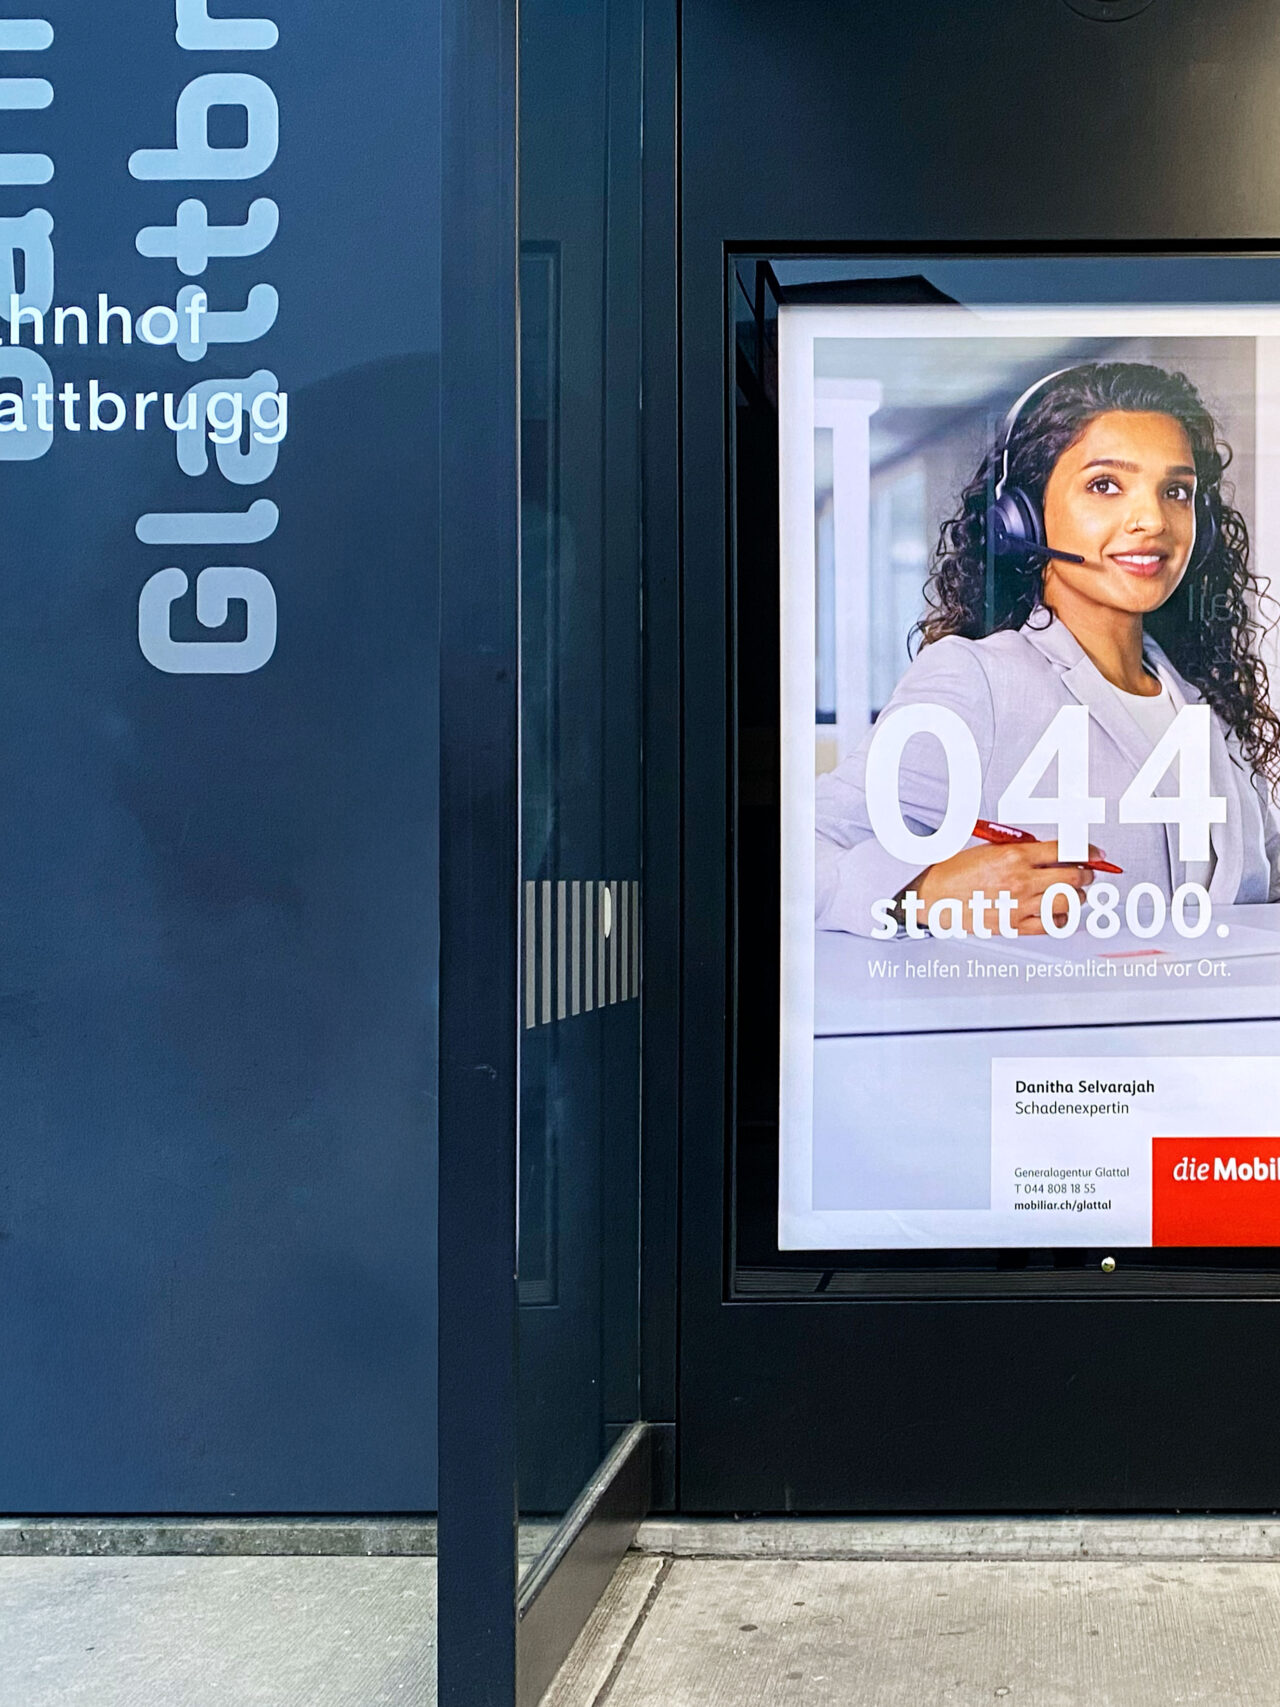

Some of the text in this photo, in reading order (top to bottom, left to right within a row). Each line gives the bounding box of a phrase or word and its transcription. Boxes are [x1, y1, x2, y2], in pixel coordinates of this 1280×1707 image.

[0, 293, 207, 345] hnhof
[865, 704, 1228, 867] 044
[870, 881, 1230, 940] statt 0800.
[868, 958, 1232, 982] Wir helfen Ihnen persönlich und vor Ort.
[1015, 1080, 1155, 1096] Danitha Selvarajah
[1015, 1101, 1129, 1117] Schadenexpertin
[1014, 1167, 1130, 1180] Generalagentur Glattal
[1014, 1184, 1096, 1194] T 044 808 18 55
[1014, 1199, 1112, 1212] mobiliar.ch/glattal
